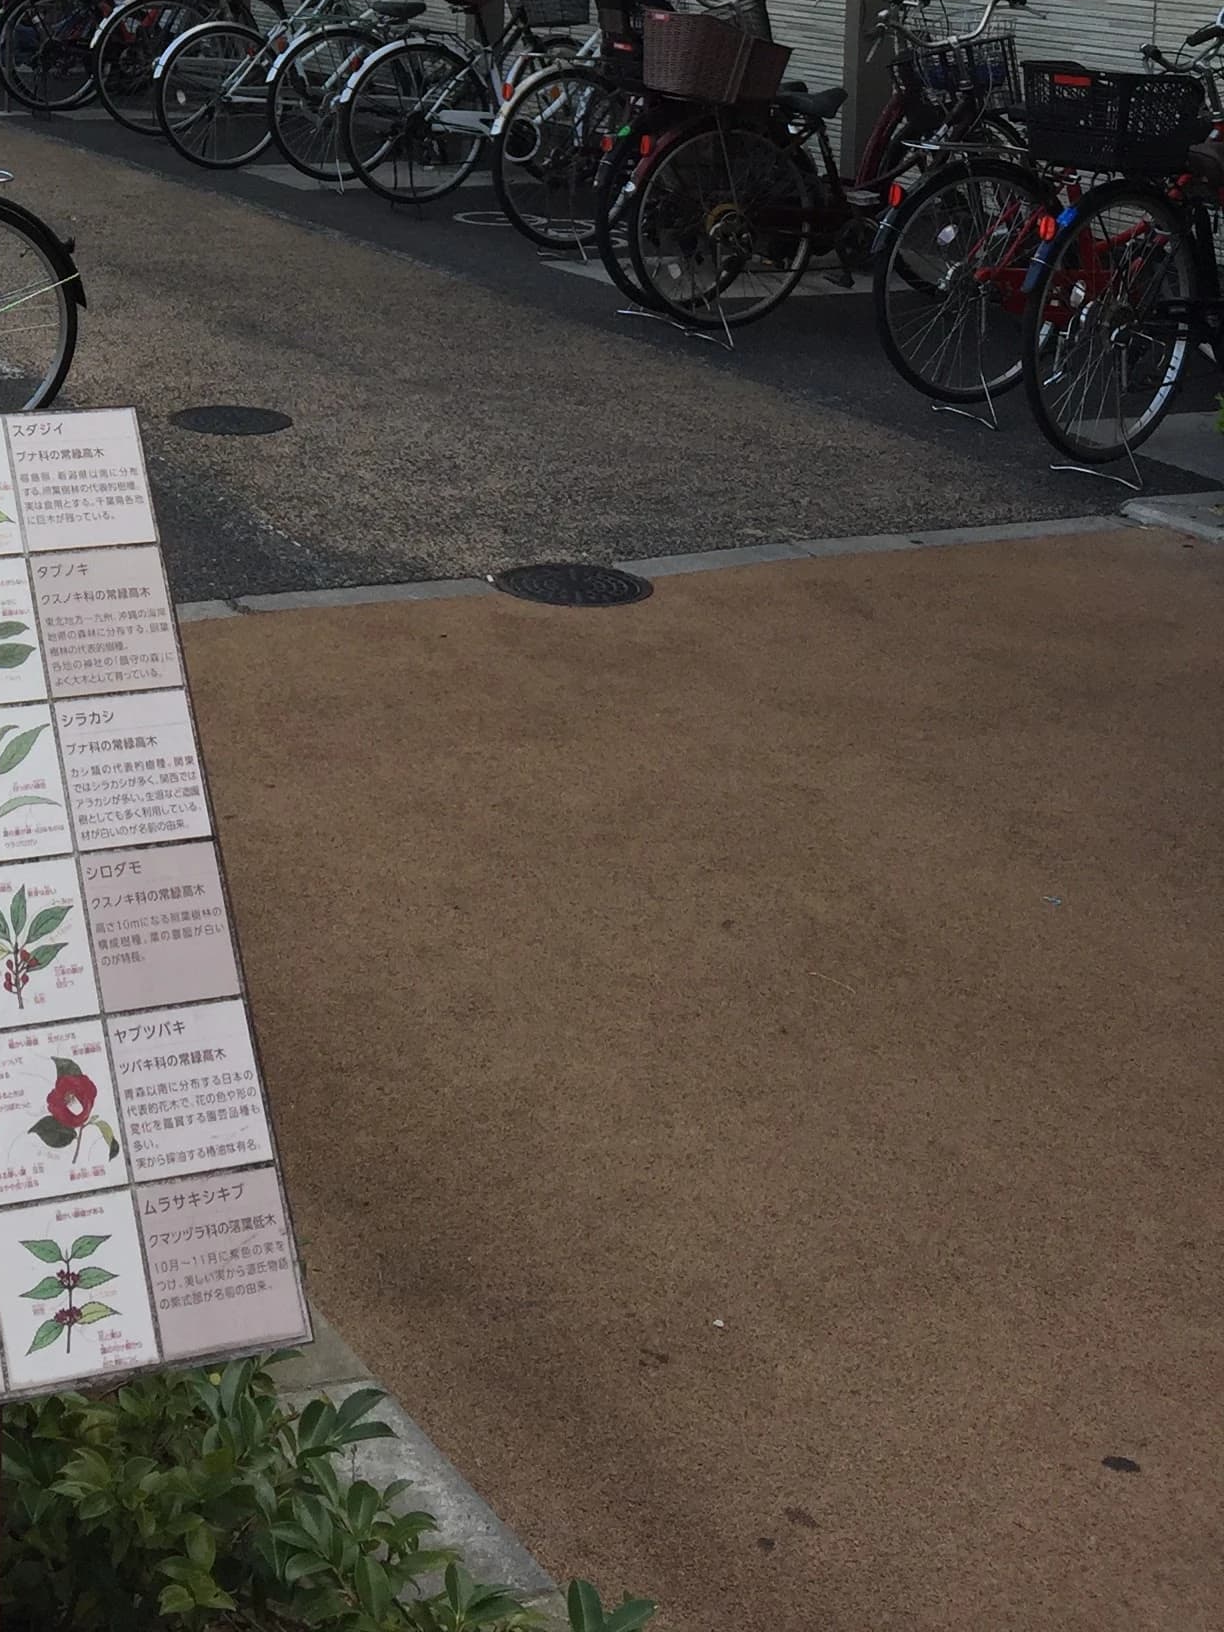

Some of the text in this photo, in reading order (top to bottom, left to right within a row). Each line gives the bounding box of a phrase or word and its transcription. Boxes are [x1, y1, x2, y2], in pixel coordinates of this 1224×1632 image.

[12, 422, 63, 437] スダジイ
[36, 563, 88, 579] タブノキ
[61, 710, 114, 727] シラカシ
[86, 860, 141, 880] シロダモ
[113, 1020, 185, 1043] ヤブツバキ
[144, 1182, 244, 1215] ムラサキシキブ
